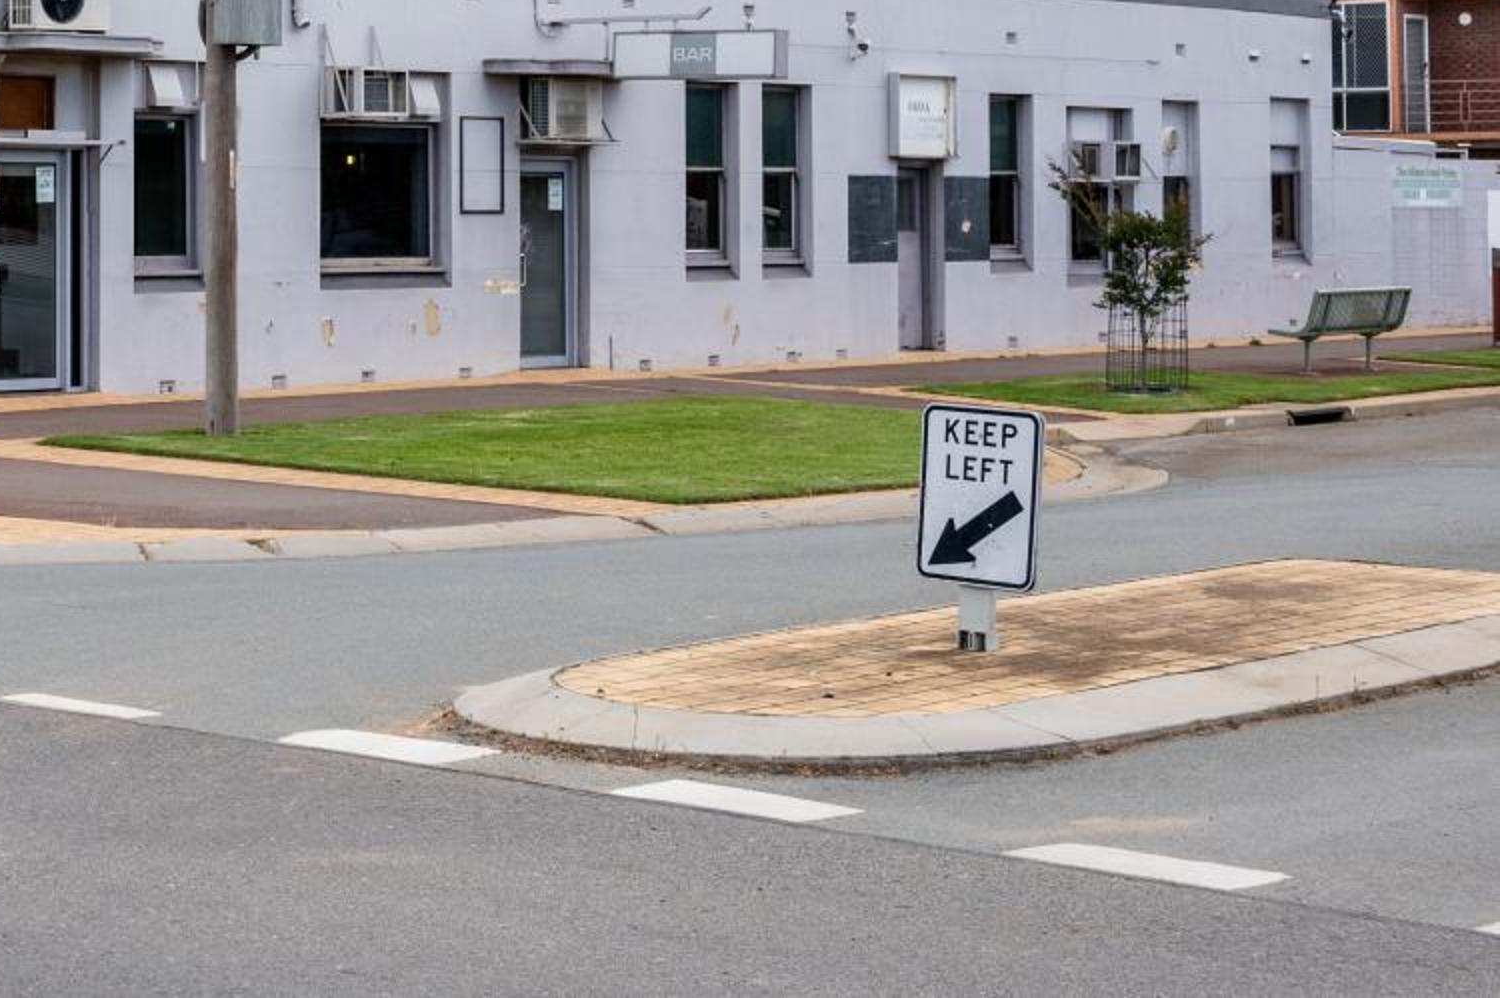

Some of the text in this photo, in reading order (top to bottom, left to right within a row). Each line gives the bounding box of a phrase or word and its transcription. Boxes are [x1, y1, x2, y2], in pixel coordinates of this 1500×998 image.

[673, 47, 712, 62] BAR
[944, 418, 1018, 448] KEEP
[945, 454, 1013, 485] LEFT
